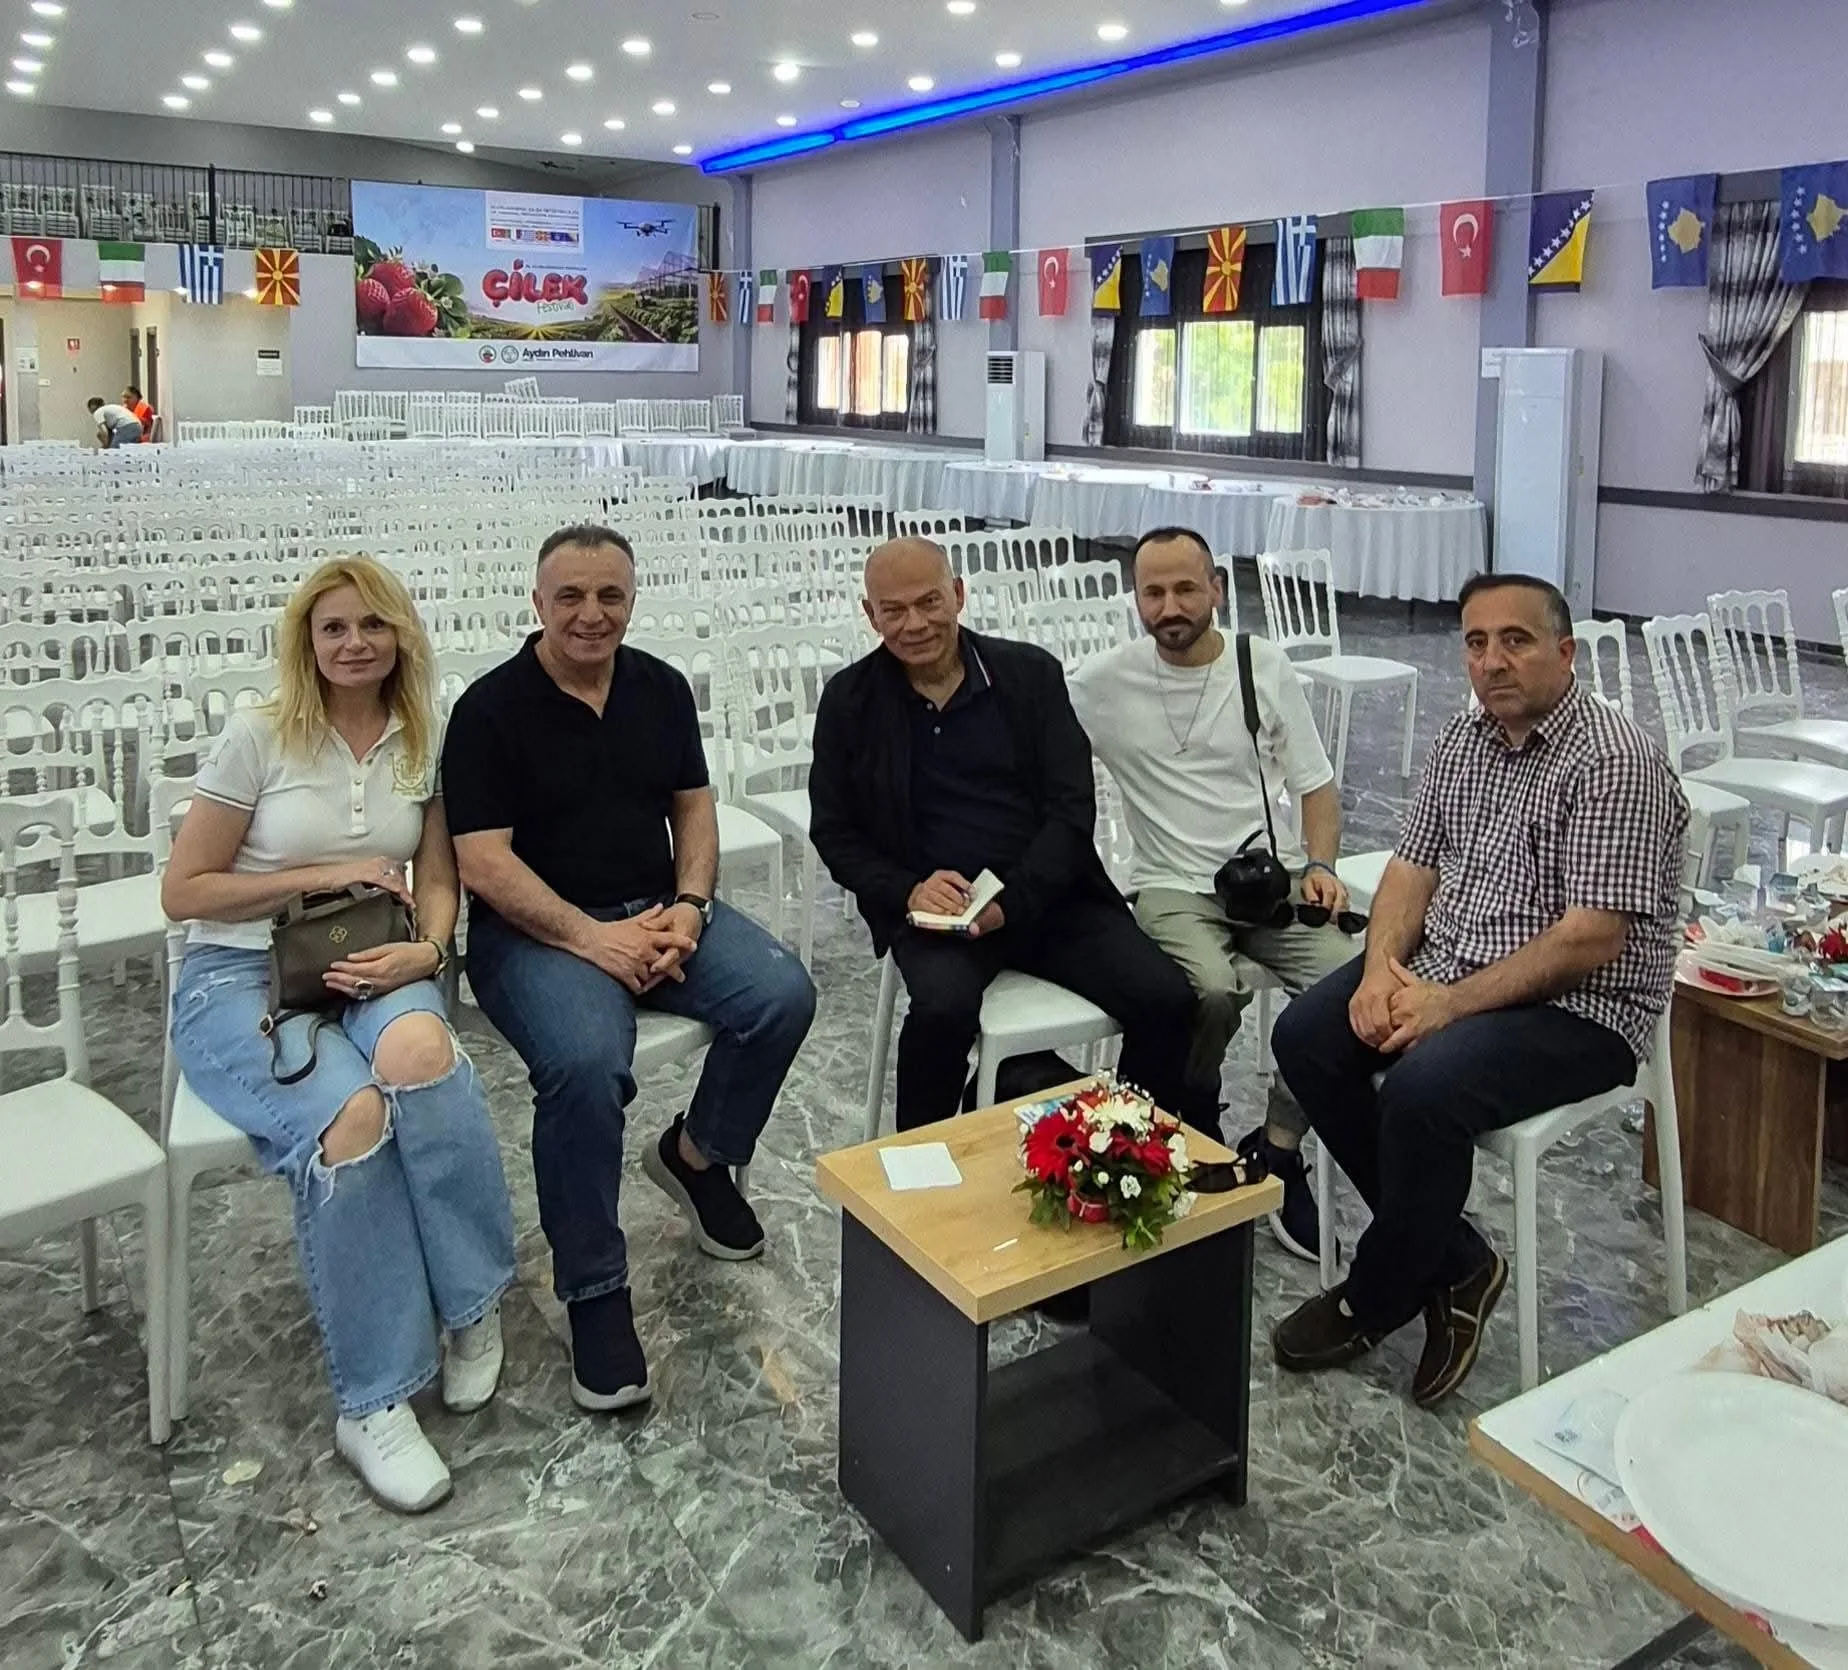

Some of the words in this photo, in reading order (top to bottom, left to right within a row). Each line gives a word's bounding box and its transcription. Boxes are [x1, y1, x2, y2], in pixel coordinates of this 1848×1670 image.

[482, 258, 588, 308] ÇİLEK
[522, 347, 550, 359] Aydın
[552, 348, 594, 358] Pehlivan
